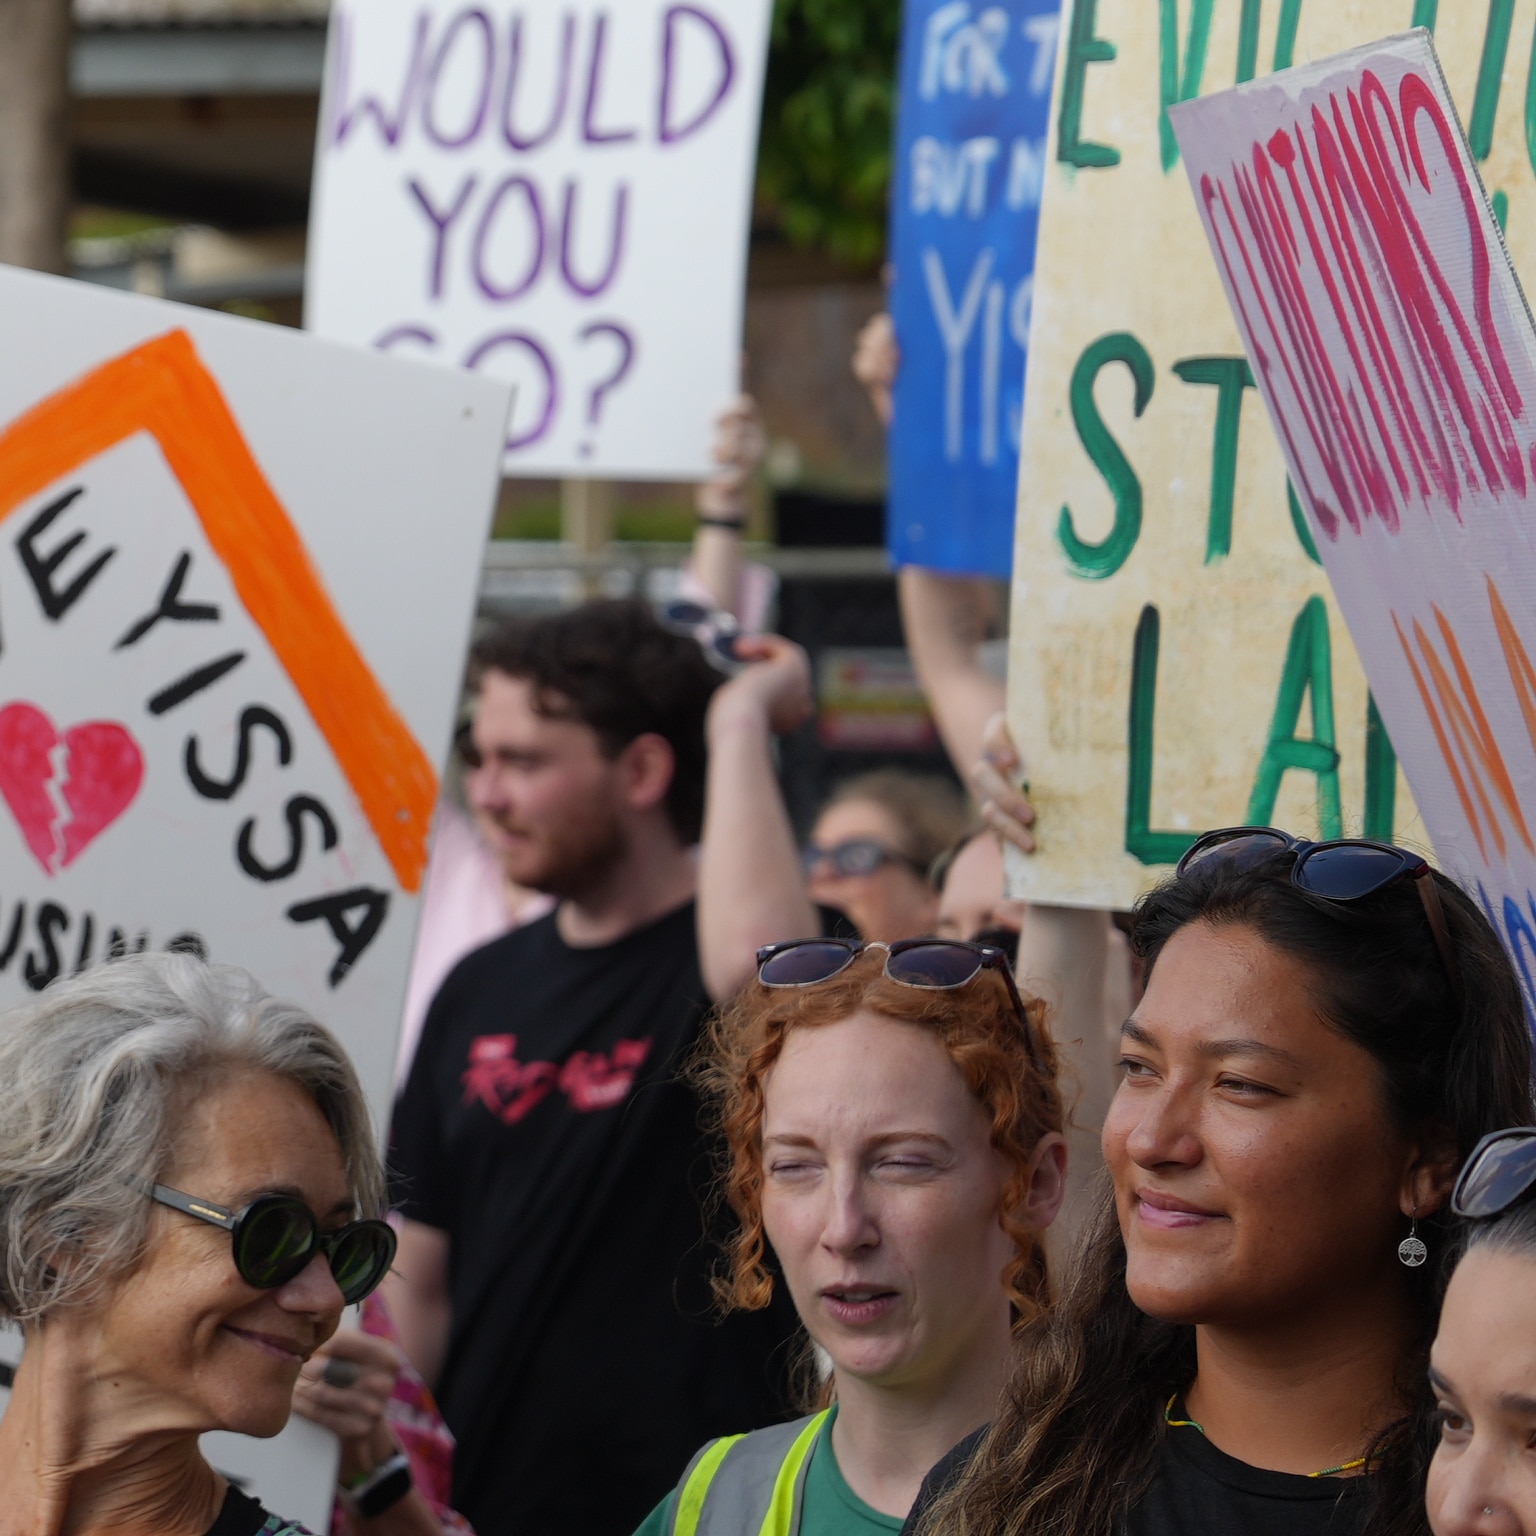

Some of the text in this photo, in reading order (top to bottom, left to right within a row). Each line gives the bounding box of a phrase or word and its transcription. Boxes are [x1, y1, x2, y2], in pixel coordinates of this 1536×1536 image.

[332, 2, 739, 154] WOULD
[405, 170, 632, 307] YOU
[1058, 329, 1324, 580] ST
[112, 551, 393, 988] YISSA
